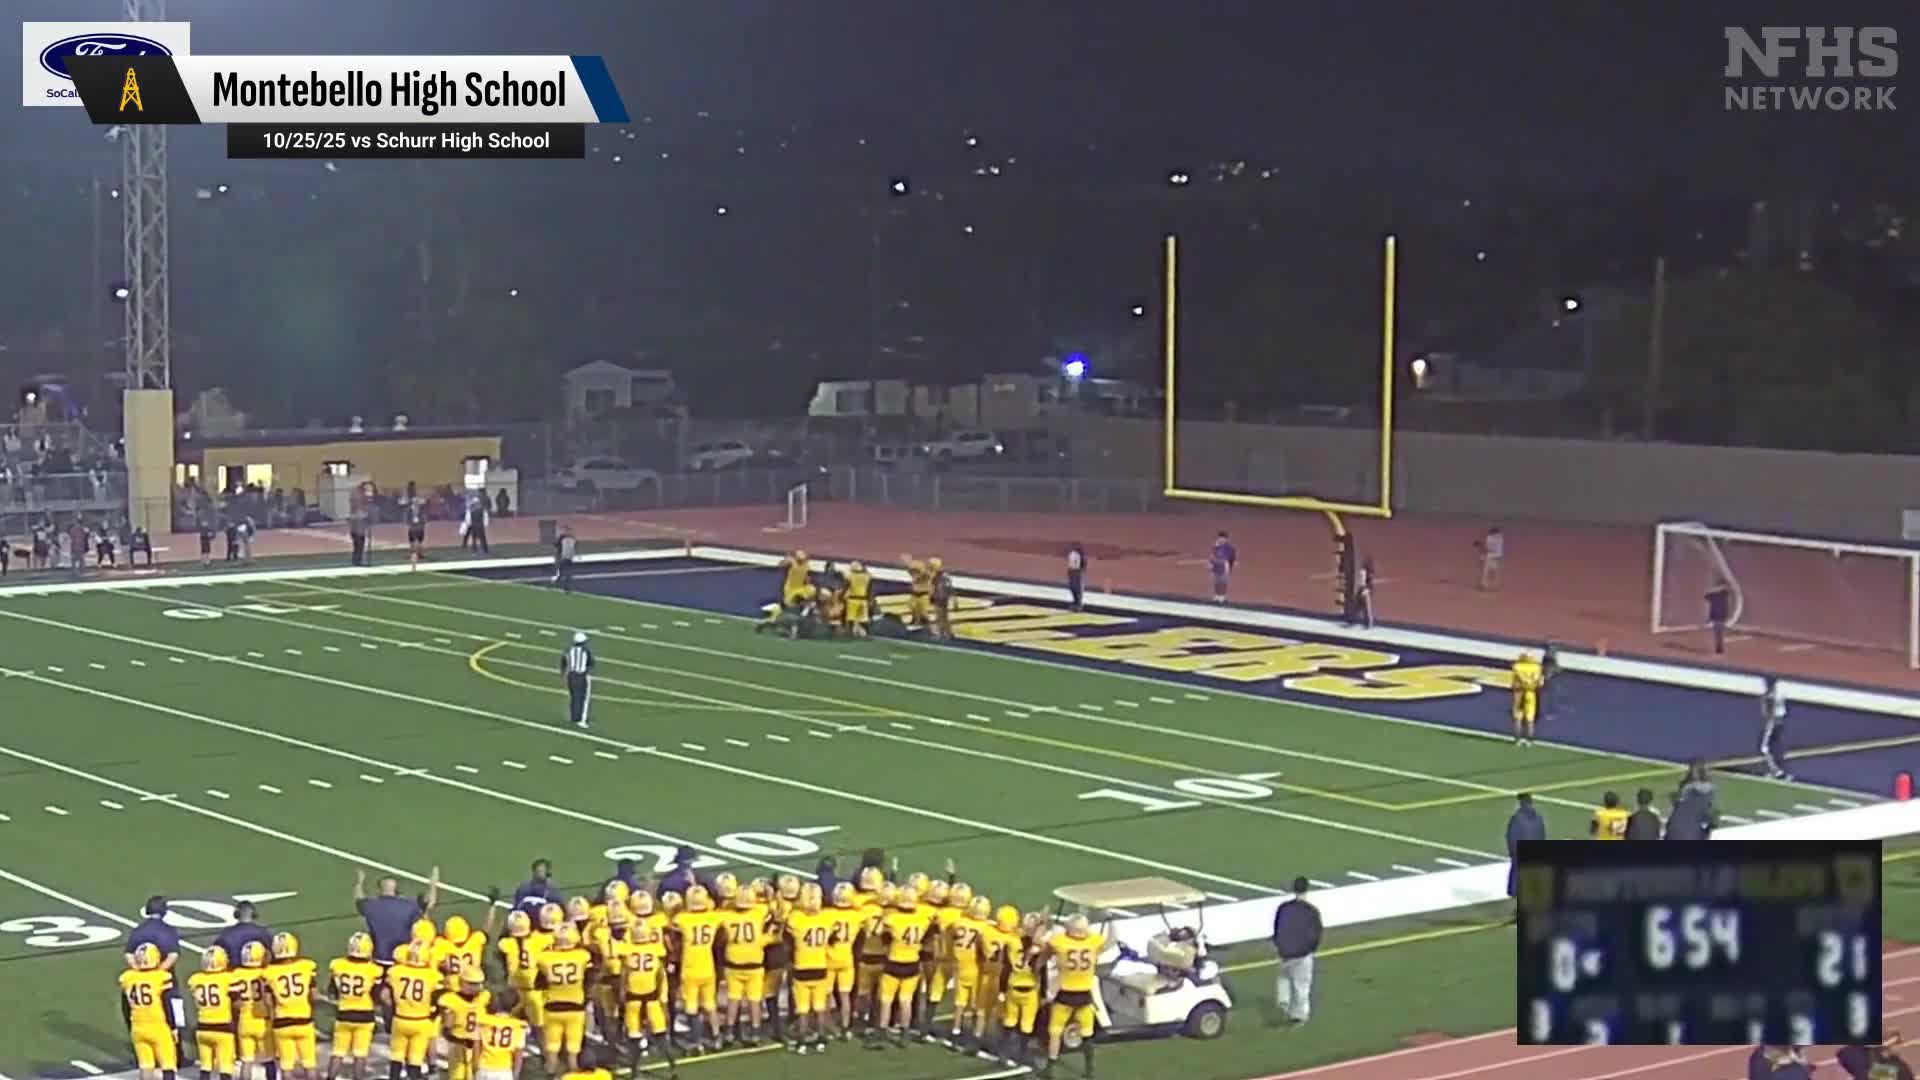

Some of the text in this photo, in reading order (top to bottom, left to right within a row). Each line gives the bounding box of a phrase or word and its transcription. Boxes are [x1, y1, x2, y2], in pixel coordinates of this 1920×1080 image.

[692, 924, 711, 945] 16
[730, 923, 754, 944] 70
[804, 927, 826, 947] 40
[902, 926, 919, 945] 41
[631, 952, 653, 971] 32
[1067, 949, 1091, 970] 55
[340, 973, 364, 996] 62
[552, 962, 577, 985] 52
[128, 983, 153, 1006] 46
[195, 983, 221, 1006] 36
[279, 972, 305, 998] 35
[400, 976, 424, 1002] 78
[488, 1026, 512, 1048] 18
